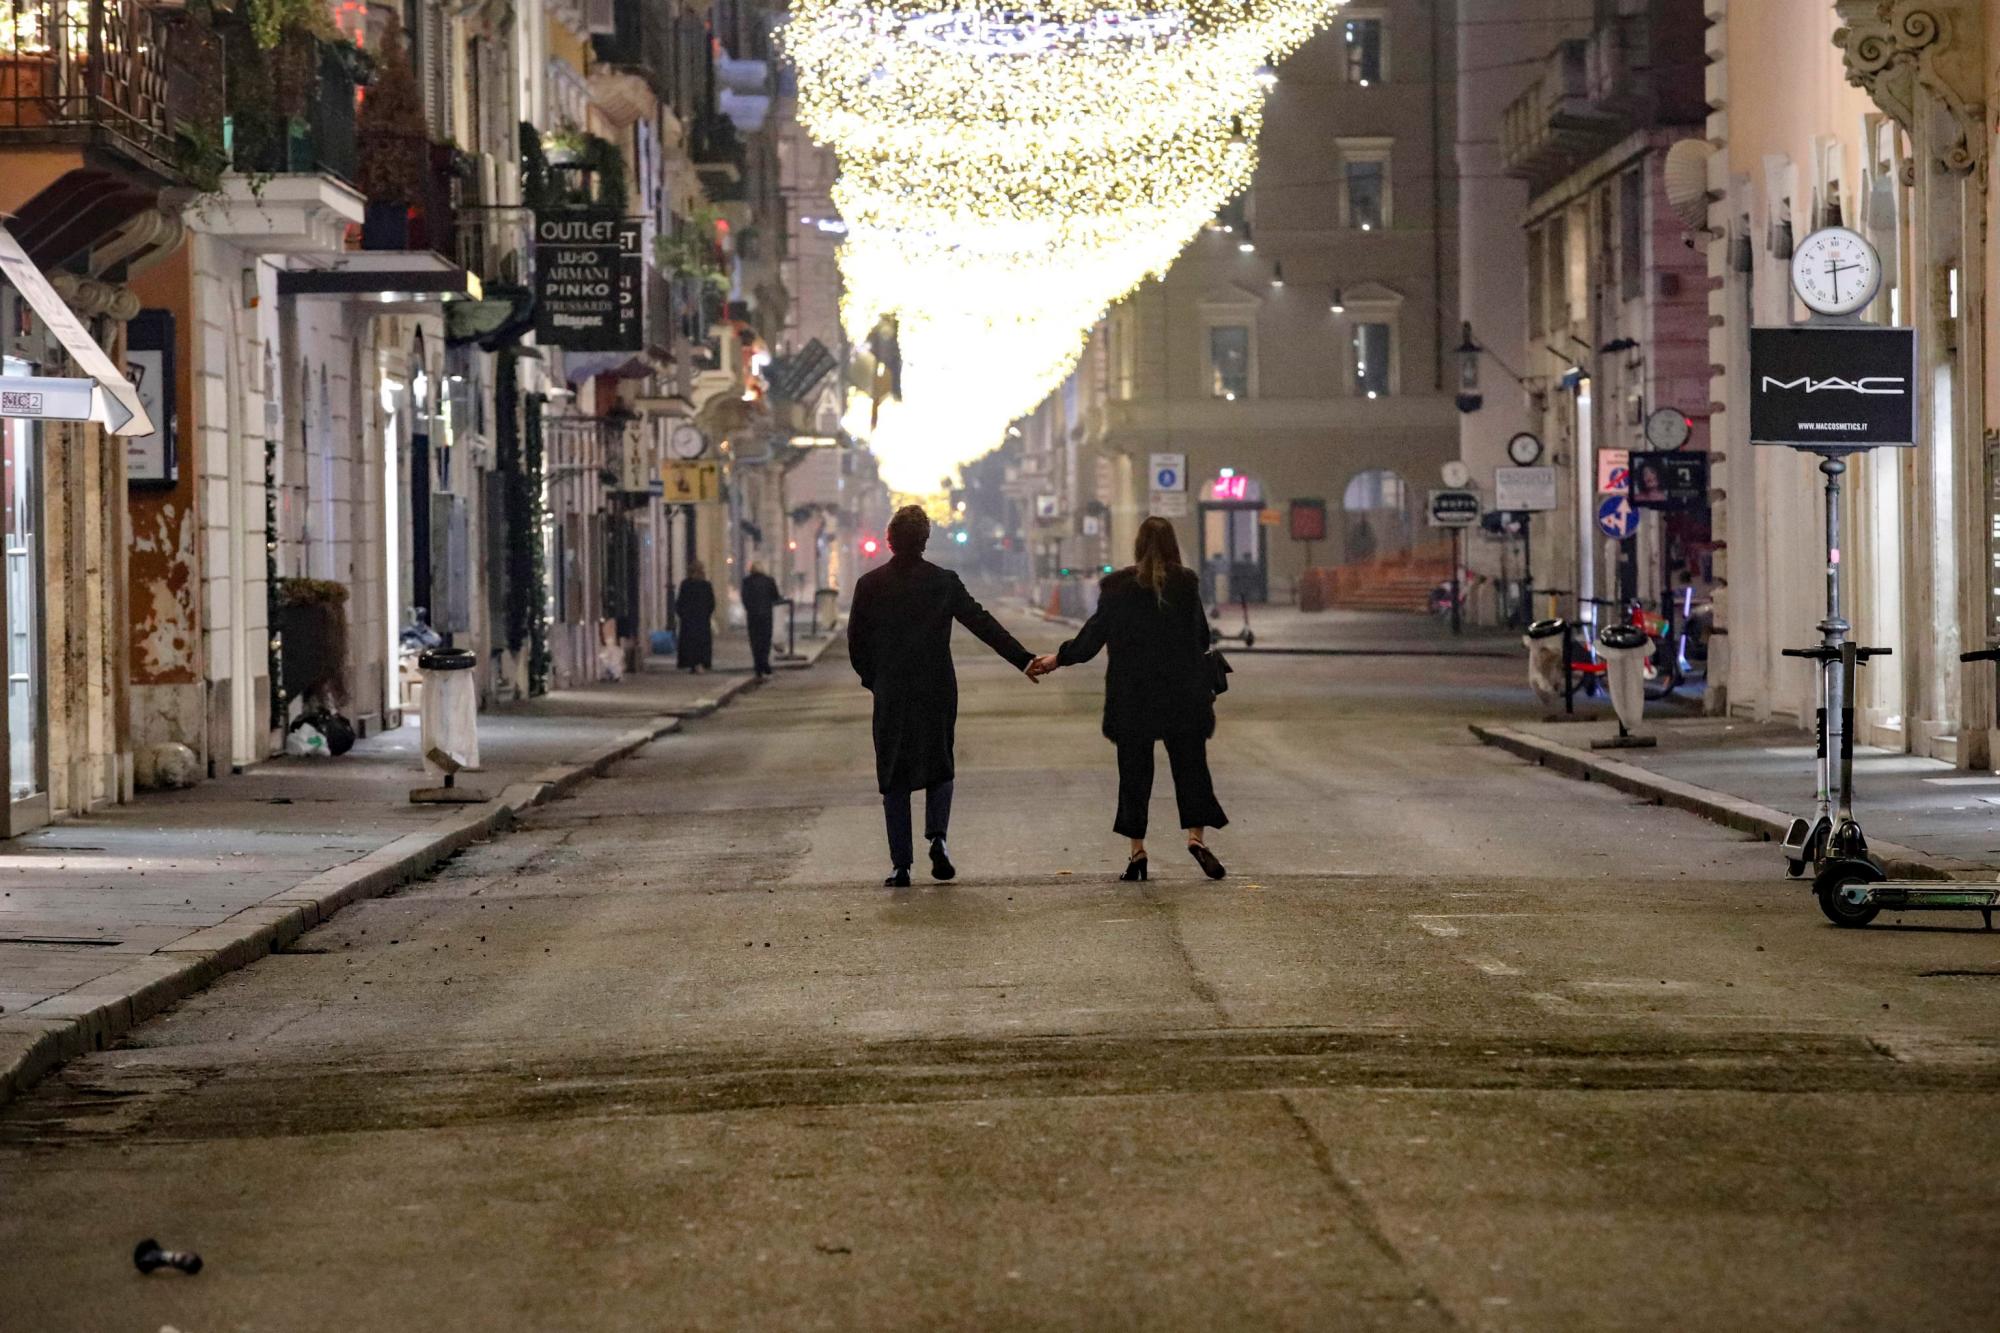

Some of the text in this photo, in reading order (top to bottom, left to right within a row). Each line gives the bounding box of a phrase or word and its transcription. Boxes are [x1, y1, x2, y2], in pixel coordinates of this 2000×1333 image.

[541, 221, 614, 239] OUTLET
[547, 267, 609, 280] ARMANI
[546, 284, 610, 296] PINKO
[1797, 422, 1868, 431] WWW.MACCOSMETICS.IT
